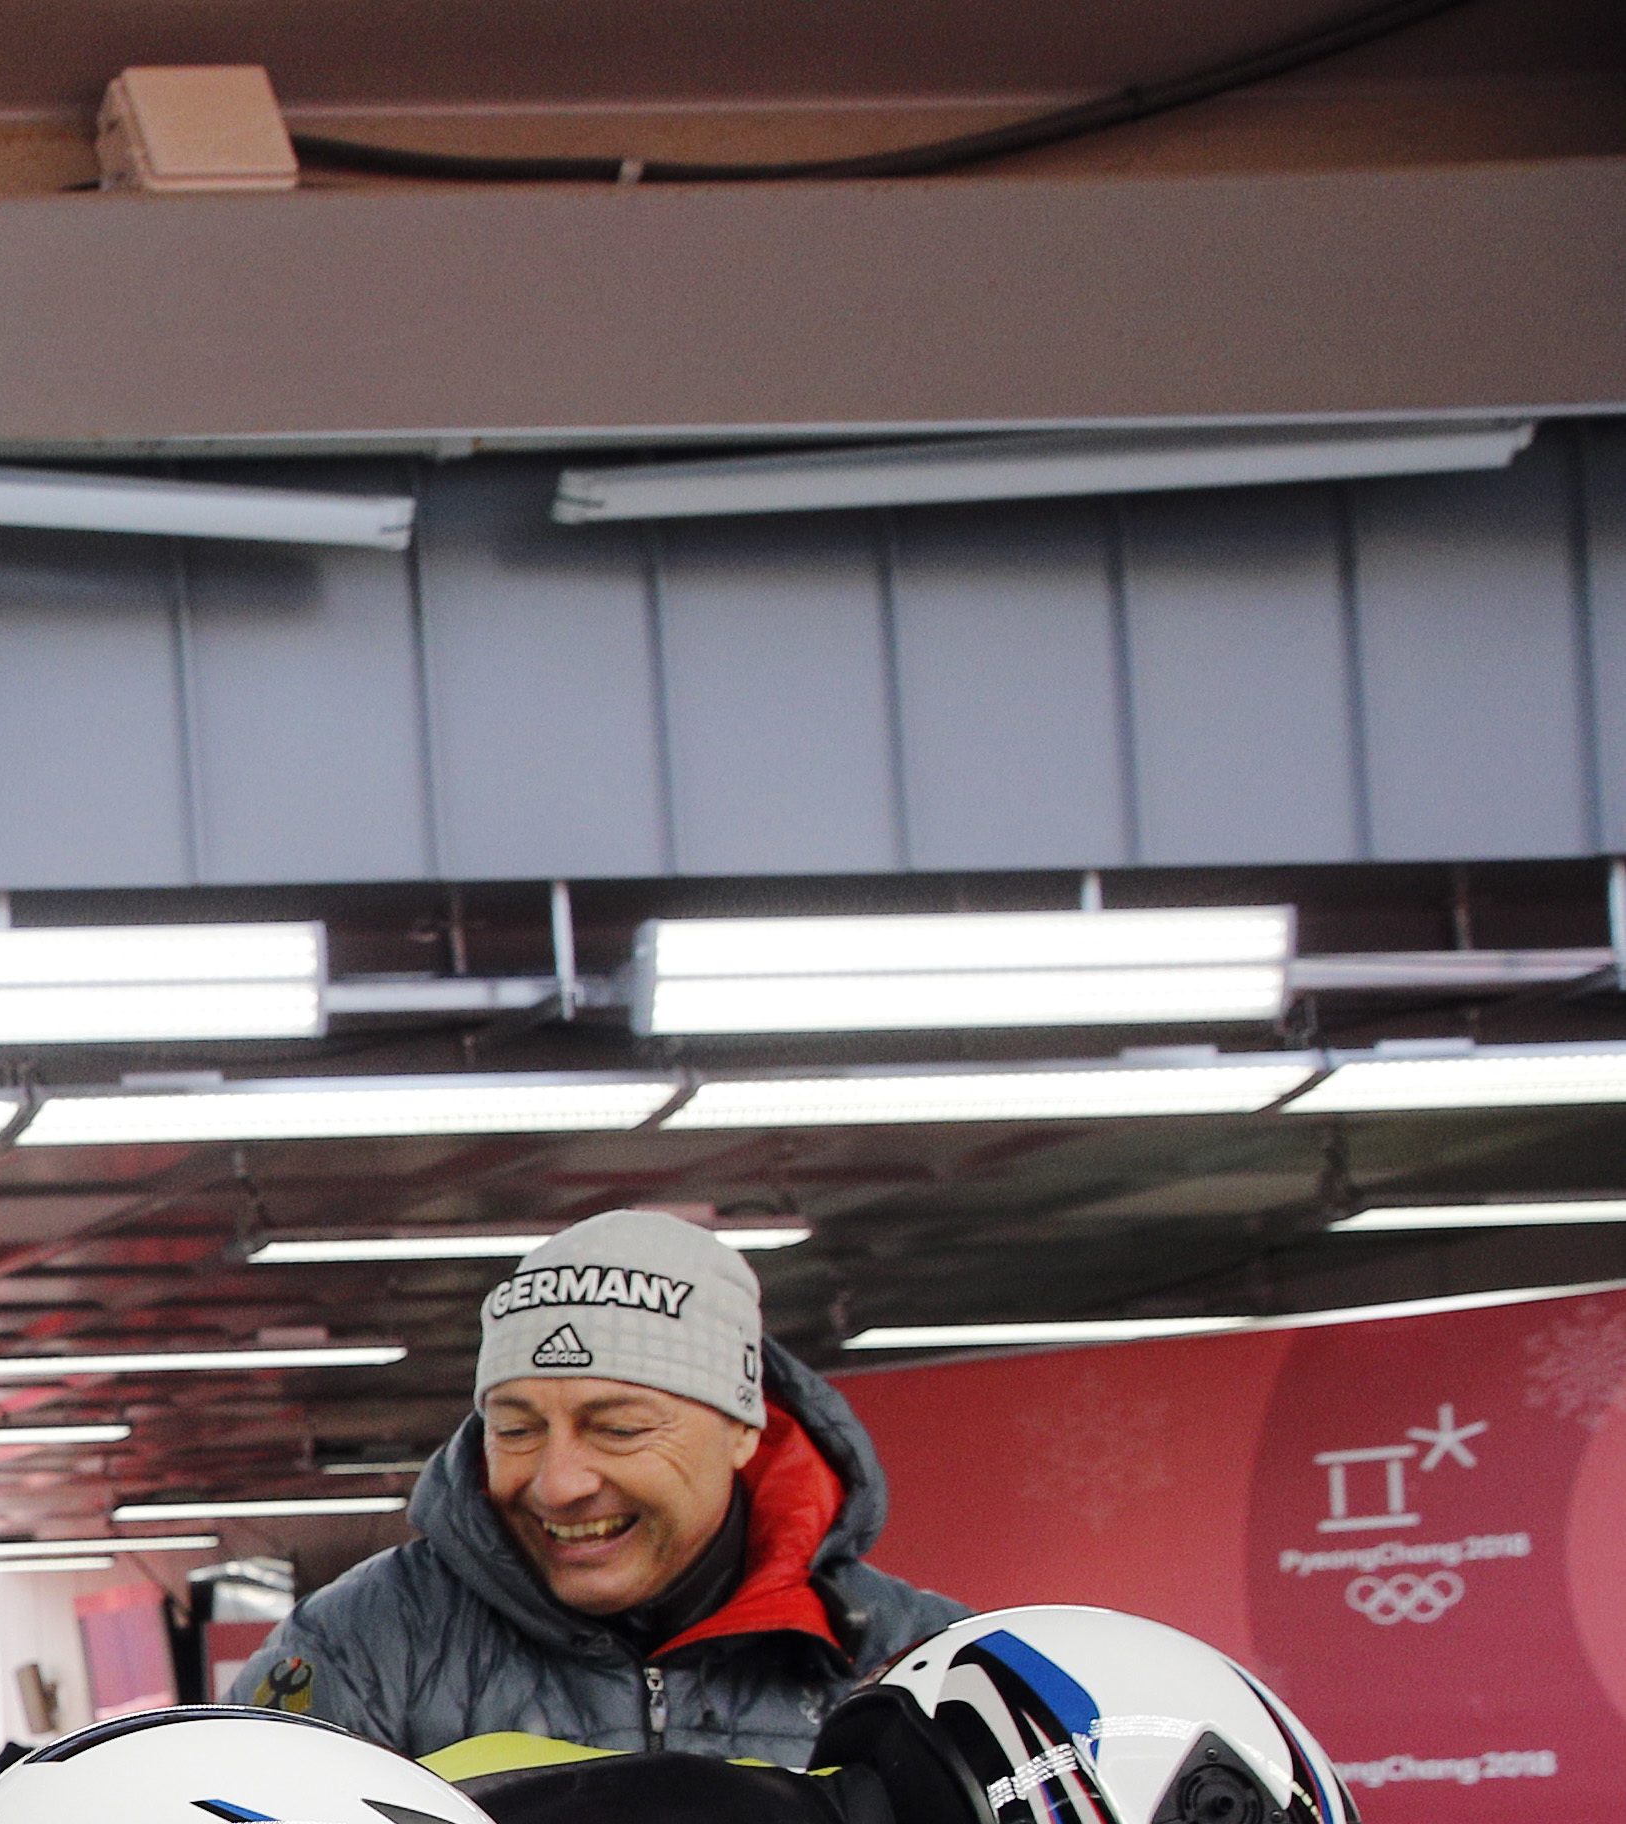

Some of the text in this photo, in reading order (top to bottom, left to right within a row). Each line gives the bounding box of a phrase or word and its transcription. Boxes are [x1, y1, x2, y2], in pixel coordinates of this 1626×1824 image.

[491, 1265, 693, 1318] GERMANY
[533, 1350, 591, 1366] adidas
[1279, 1532, 1532, 1577] PyeongChang 2018
[1481, 1750, 1557, 1778] 2018
